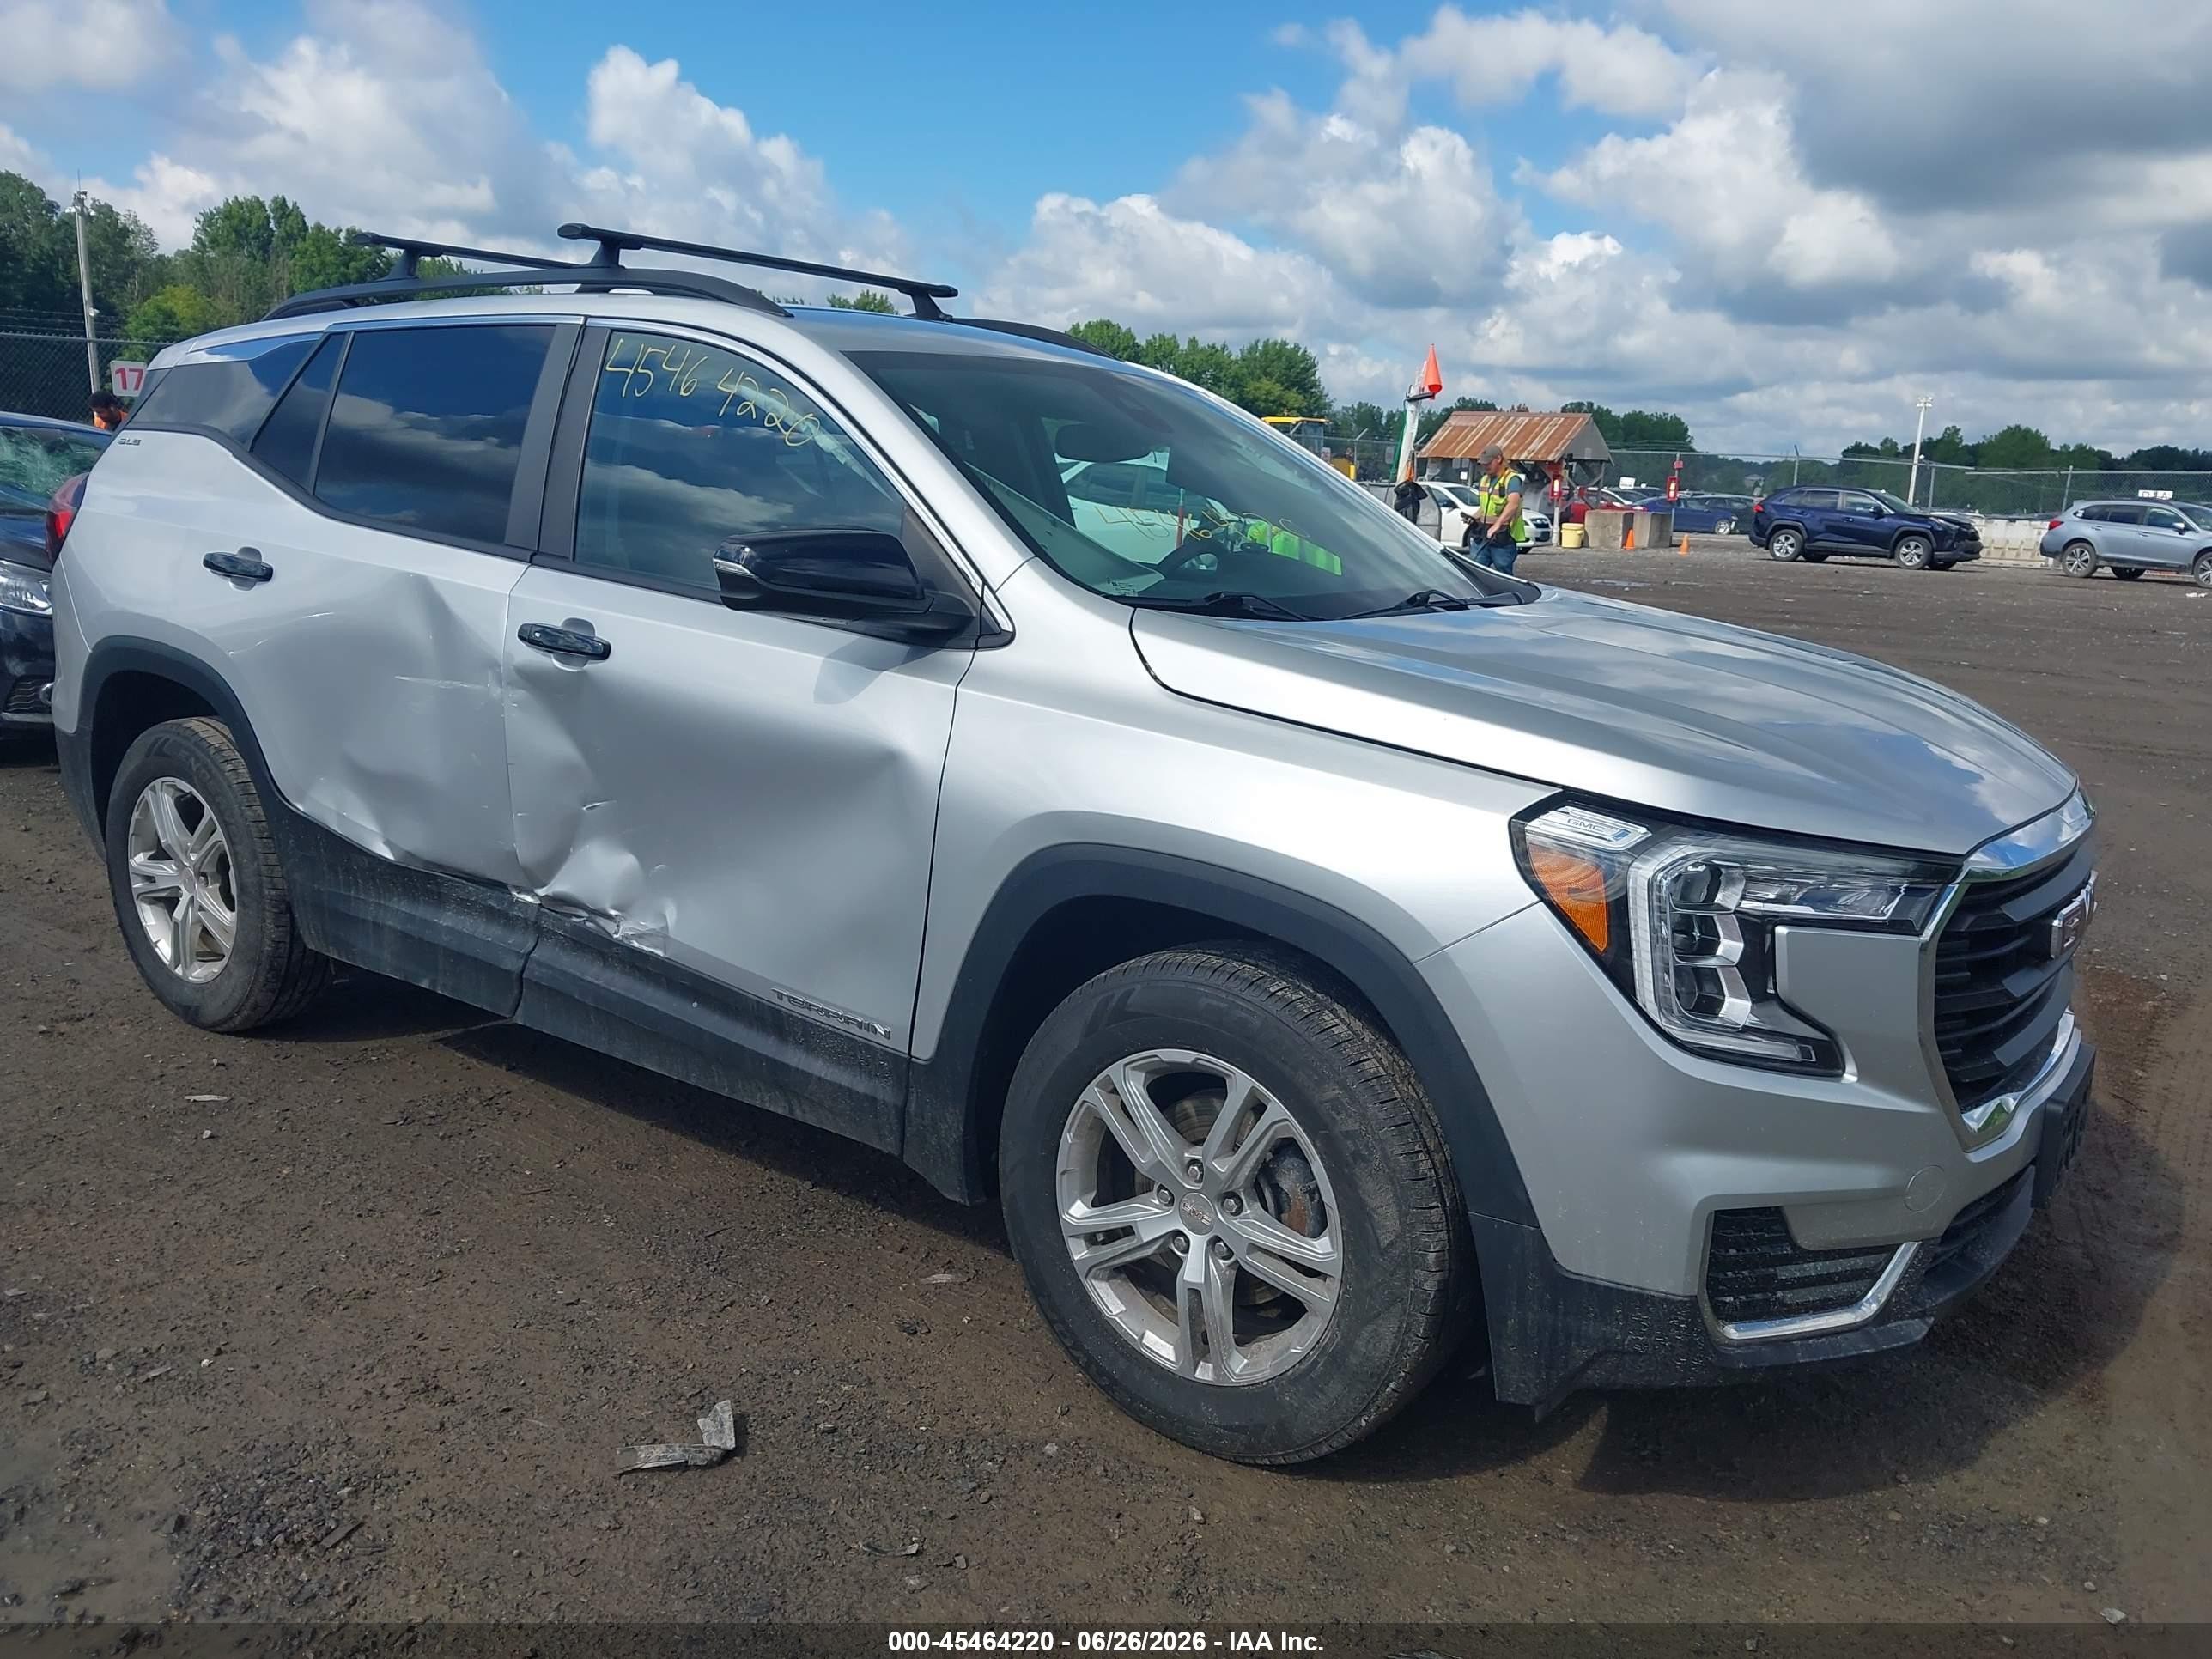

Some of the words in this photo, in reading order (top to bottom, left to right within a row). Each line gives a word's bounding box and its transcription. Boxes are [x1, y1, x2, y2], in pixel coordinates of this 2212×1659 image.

[114, 367, 144, 391] 17
[605, 337, 708, 398] 4546
[716, 368, 821, 446] 4220
[1566, 817, 1607, 832] GMC
[770, 988, 892, 1040] TERRAIN
[1182, 1202, 1212, 1226] GMC
